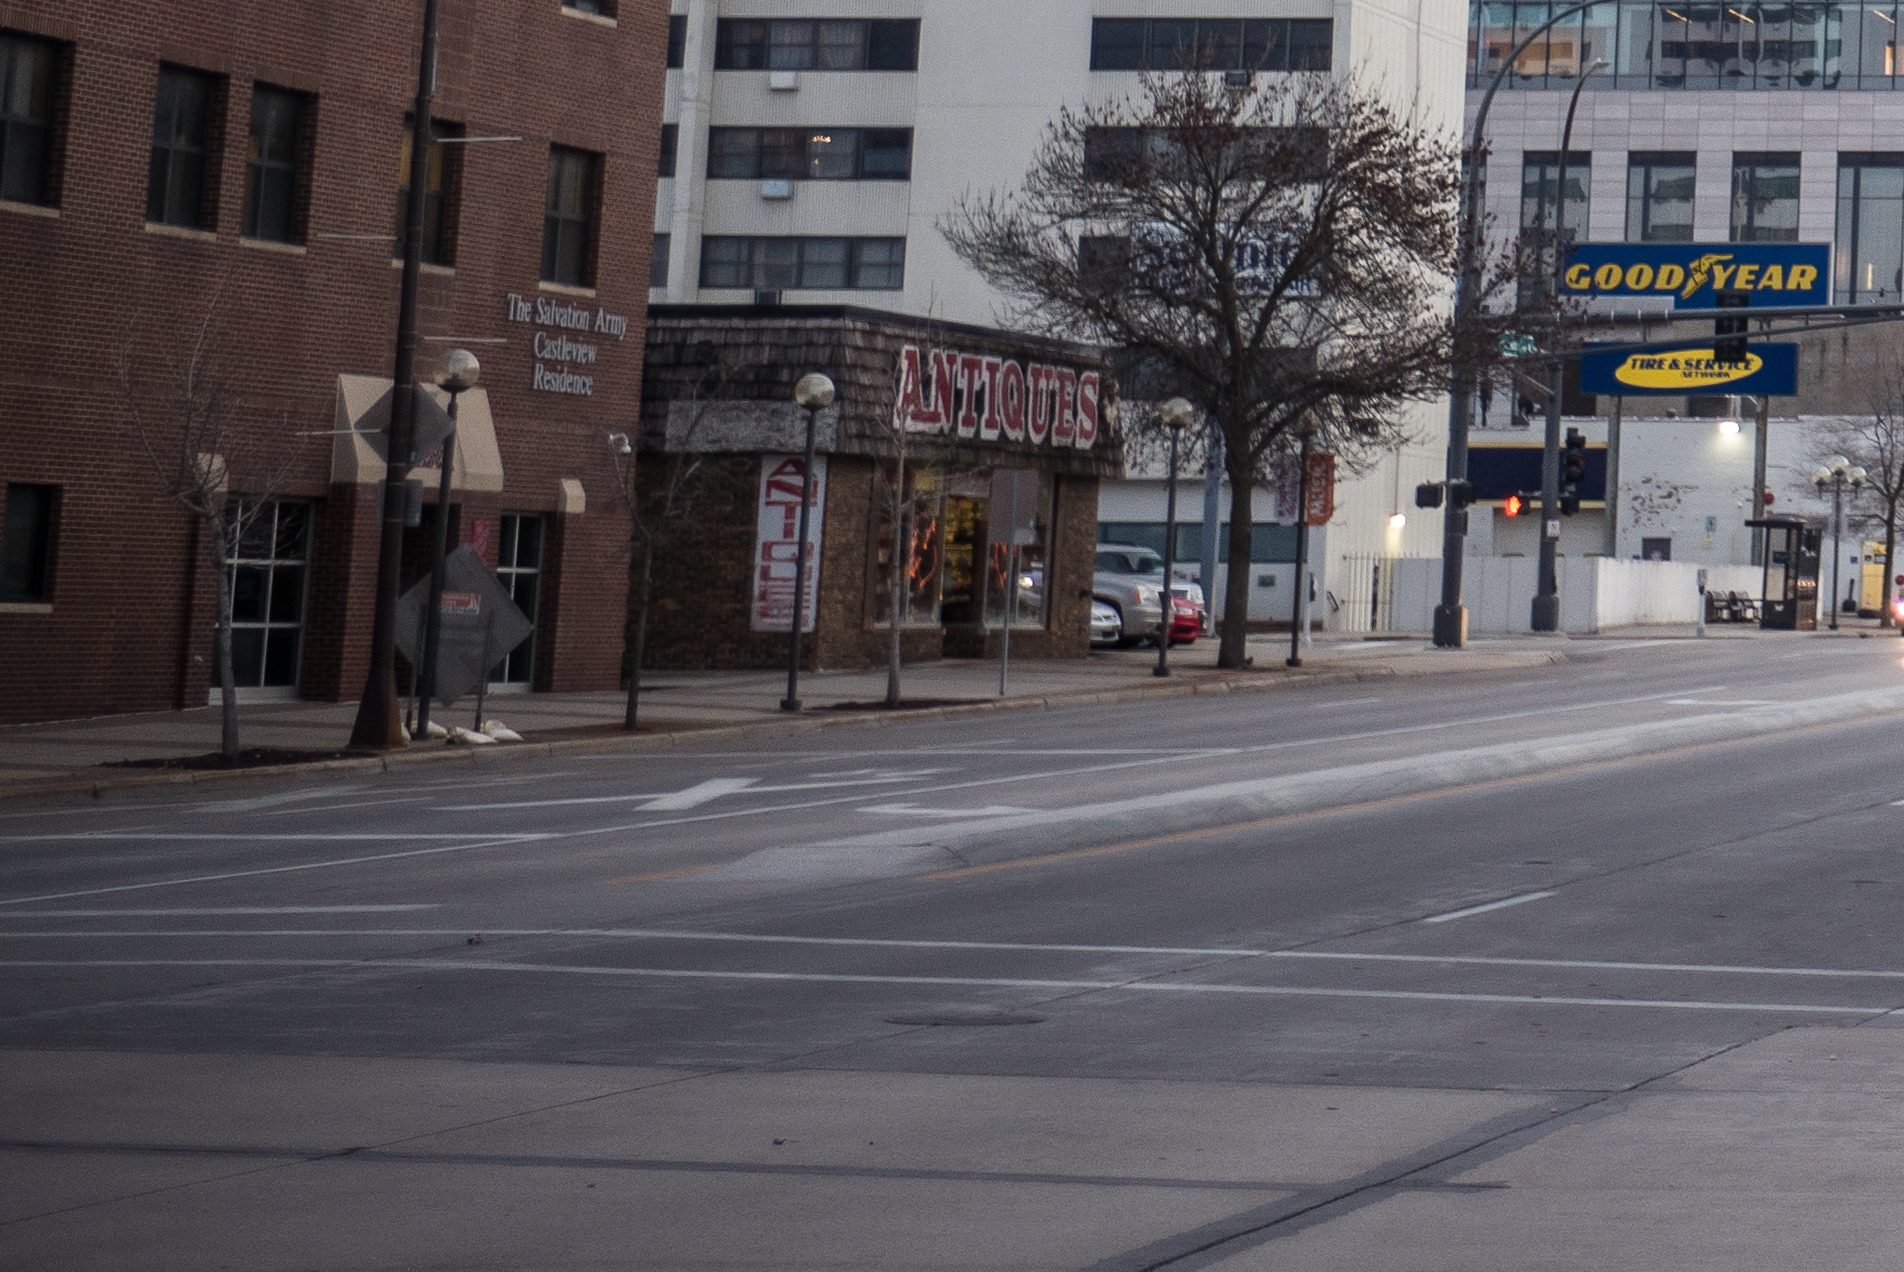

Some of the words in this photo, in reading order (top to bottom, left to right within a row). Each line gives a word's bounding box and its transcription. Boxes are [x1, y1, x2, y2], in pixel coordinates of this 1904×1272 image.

[507, 292, 532, 322] The
[536, 296, 590, 331] Salvation
[595, 306, 628, 341] Army
[533, 331, 598, 363] Castleview
[532, 363, 594, 395] Residence
[1630, 358, 1666, 370] TIRE
[893, 344, 1099, 450] ANTIQUES
